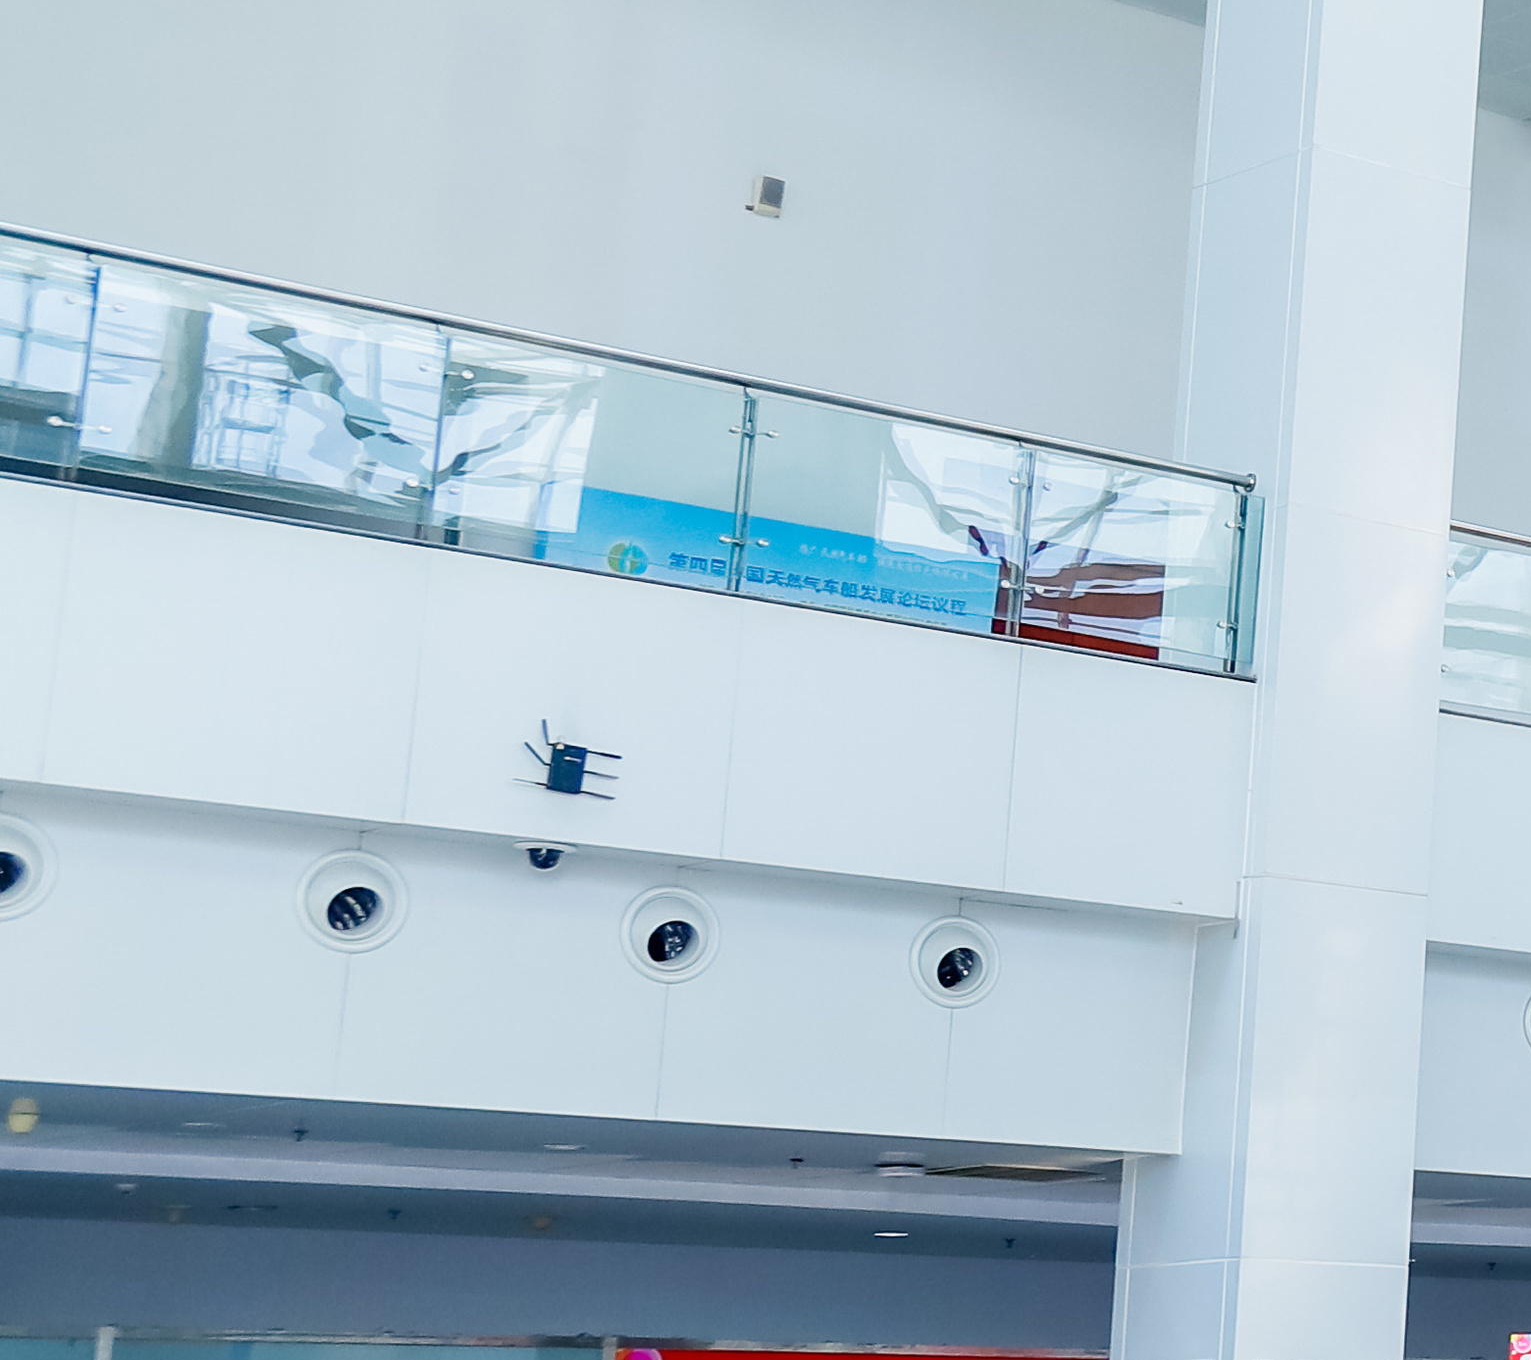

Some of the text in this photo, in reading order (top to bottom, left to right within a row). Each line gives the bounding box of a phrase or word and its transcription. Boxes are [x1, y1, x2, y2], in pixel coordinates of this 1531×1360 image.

[667, 551, 968, 617] 第四届国天然气车船发展论坛议程
